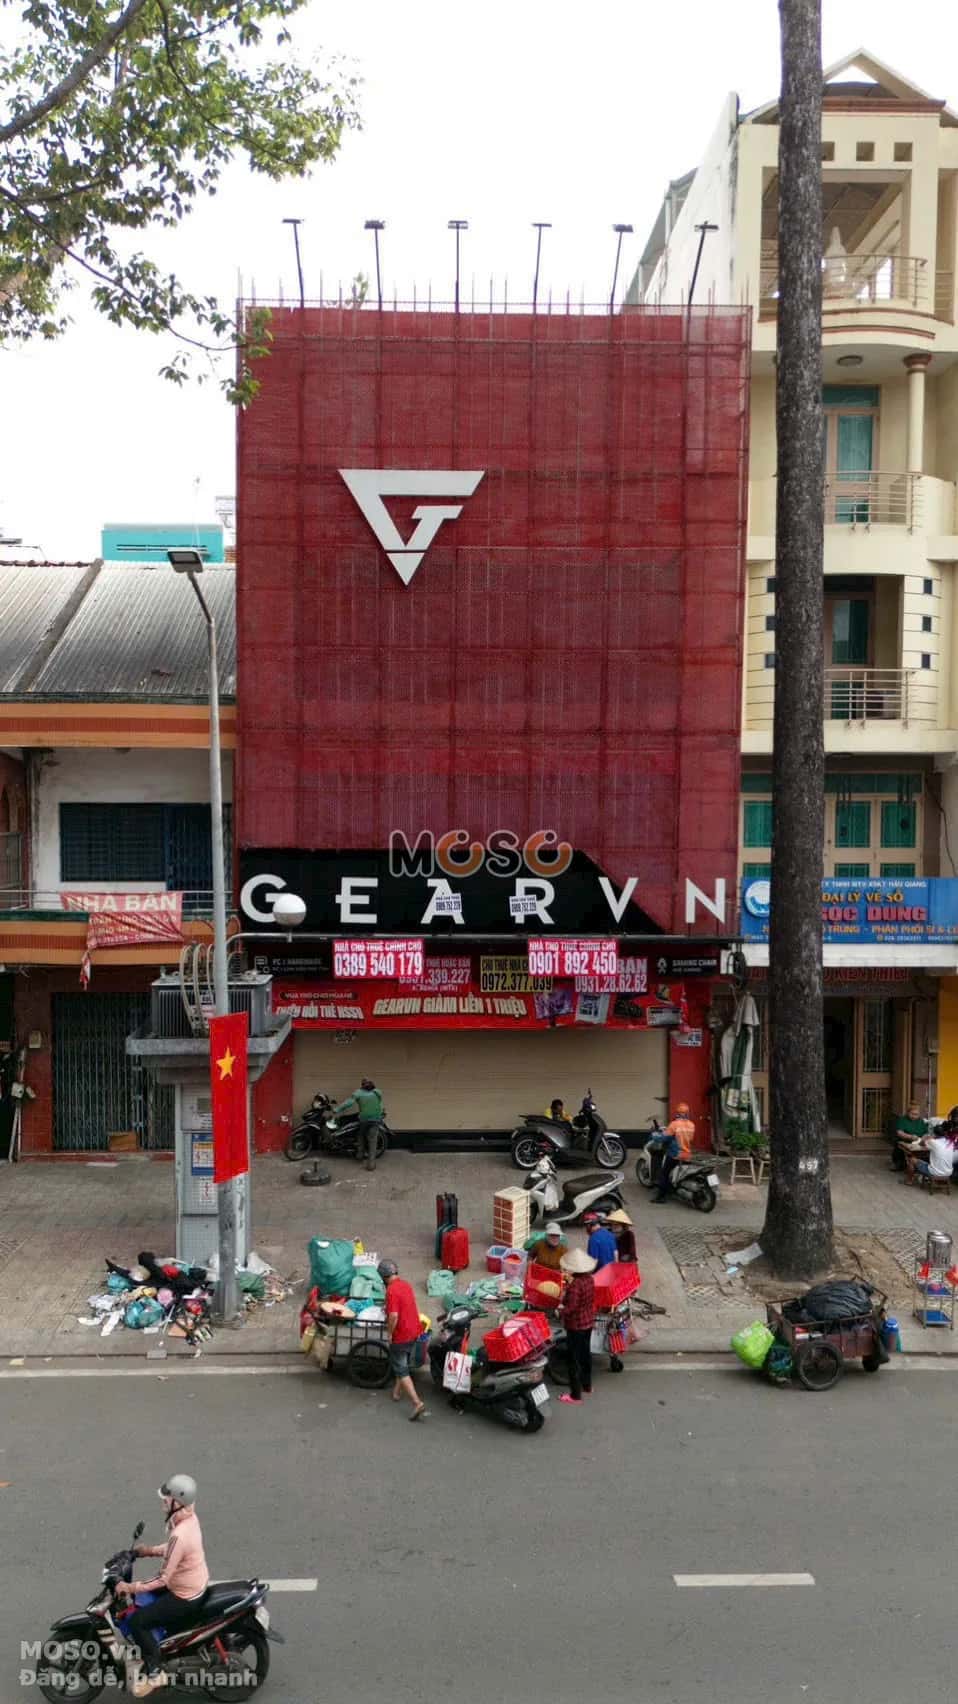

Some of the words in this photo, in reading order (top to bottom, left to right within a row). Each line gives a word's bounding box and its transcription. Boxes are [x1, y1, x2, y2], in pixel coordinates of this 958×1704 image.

[240, 873, 726, 925] GEARVN
[822, 892, 845, 904] ĐẠI
[847, 891, 861, 903] LÝ
[886, 889, 904, 903] SỐ
[822, 906, 858, 923] ỌC
[867, 906, 928, 921] DUNG
[334, 952, 367, 977] 0389
[370, 952, 394, 976] 540
[398, 951, 423, 976] 179
[528, 951, 560, 975] 0901
[564, 951, 589, 975] 892
[592, 951, 617, 975] 450
[574, 975, 648, 992] 0931.28.62.62
[373, 996, 421, 1015] GEARVN
[486, 998, 493, 1014] 1
